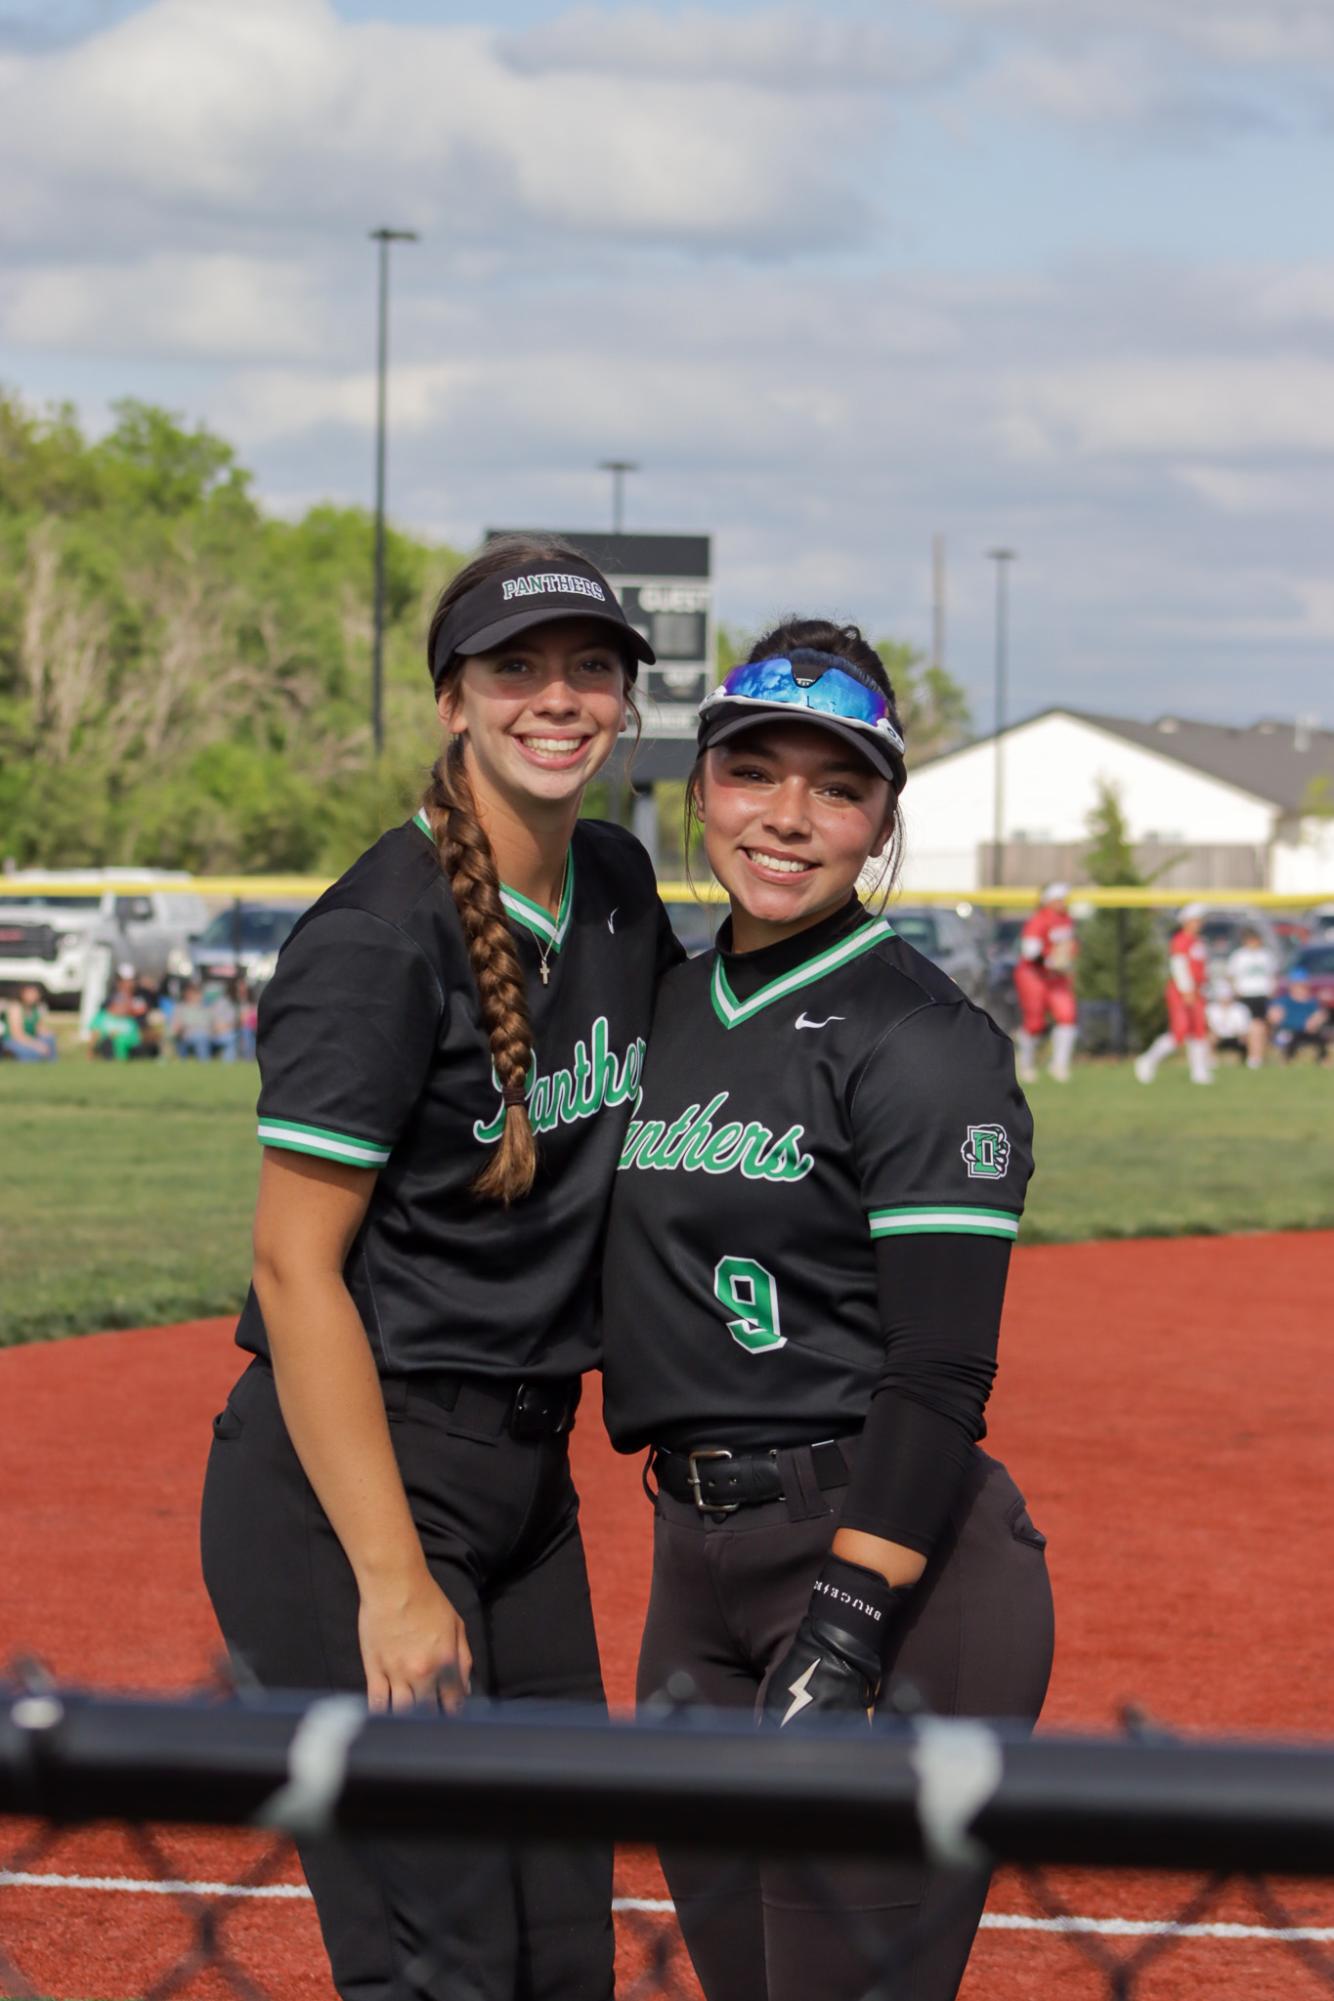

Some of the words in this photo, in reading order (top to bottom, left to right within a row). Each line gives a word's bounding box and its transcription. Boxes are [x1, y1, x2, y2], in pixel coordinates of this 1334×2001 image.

[502, 573, 606, 602] PANTHERS
[617, 1087, 815, 1182] nthers
[714, 1255, 788, 1354] 9
